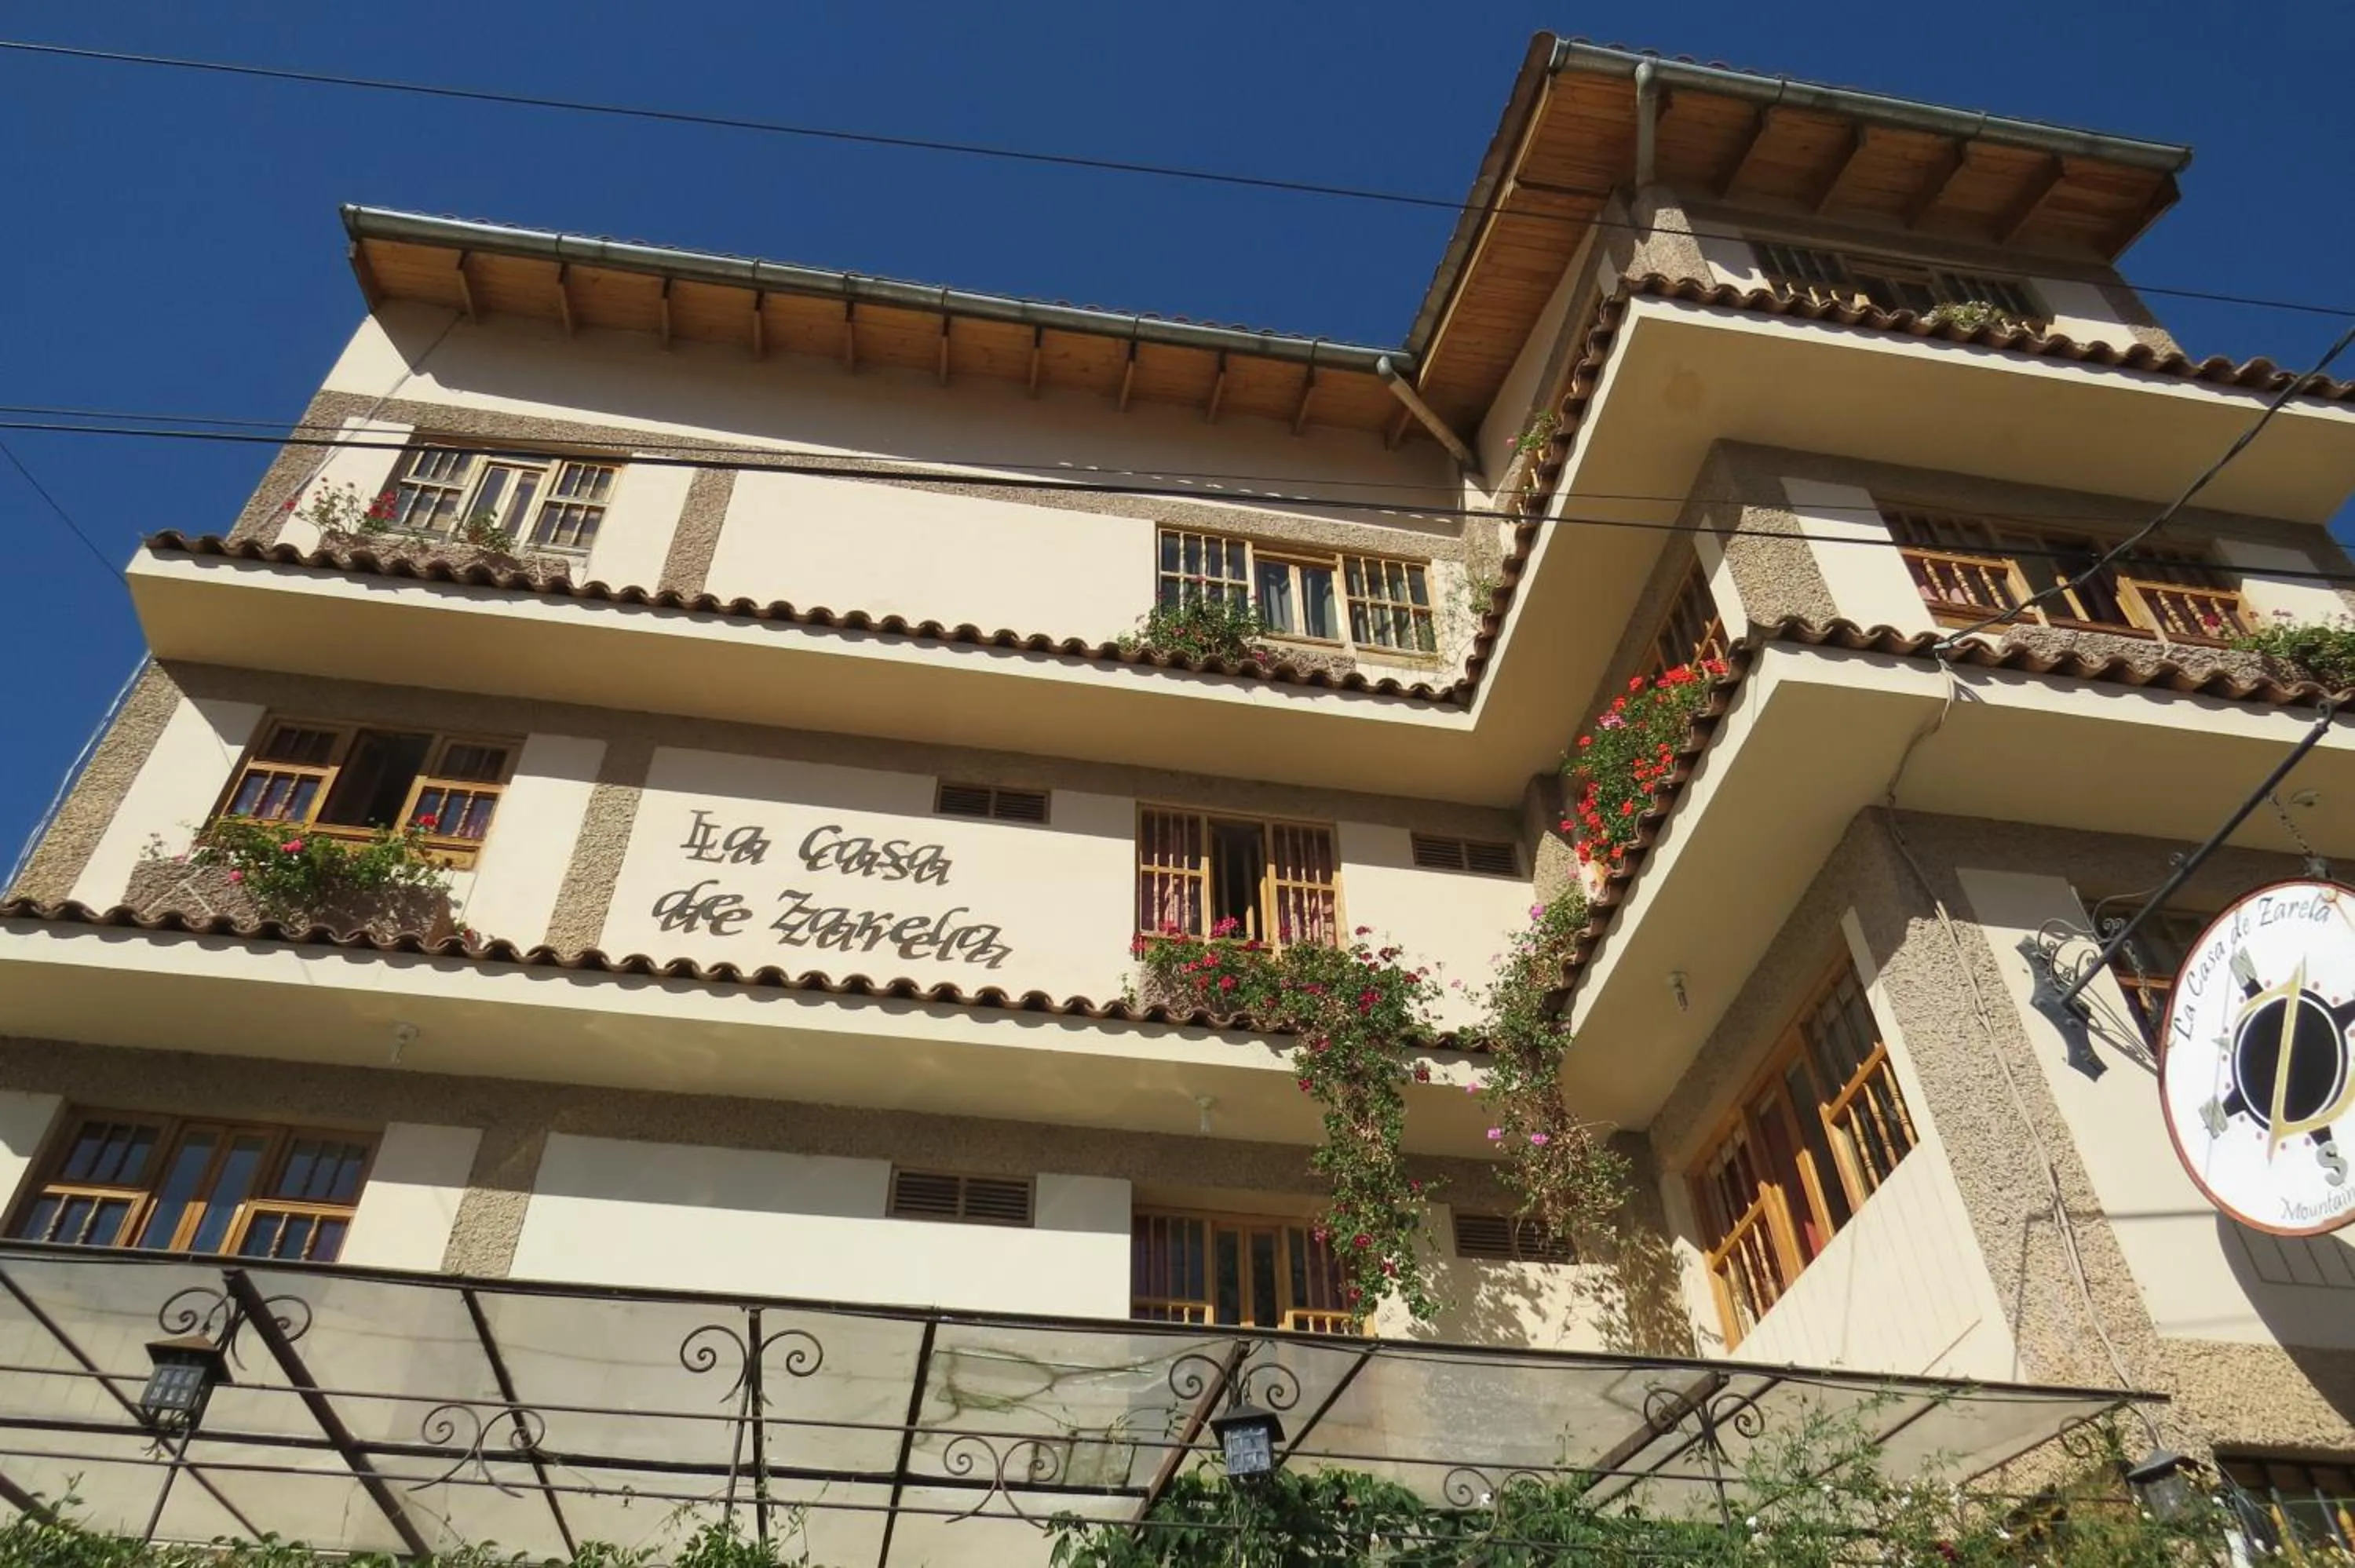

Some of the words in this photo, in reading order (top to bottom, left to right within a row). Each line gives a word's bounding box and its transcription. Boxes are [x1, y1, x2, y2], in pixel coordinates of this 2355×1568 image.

[680, 809, 771, 865] La
[798, 824, 953, 886] Casa
[652, 879, 754, 936] de
[769, 889, 1013, 969] Zarela
[2173, 1004, 2196, 1041] La
[2186, 941, 2225, 997] Casa
[2230, 911, 2250, 945] de
[2258, 893, 2331, 927] Zarela
[2316, 1140, 2349, 1187] S
